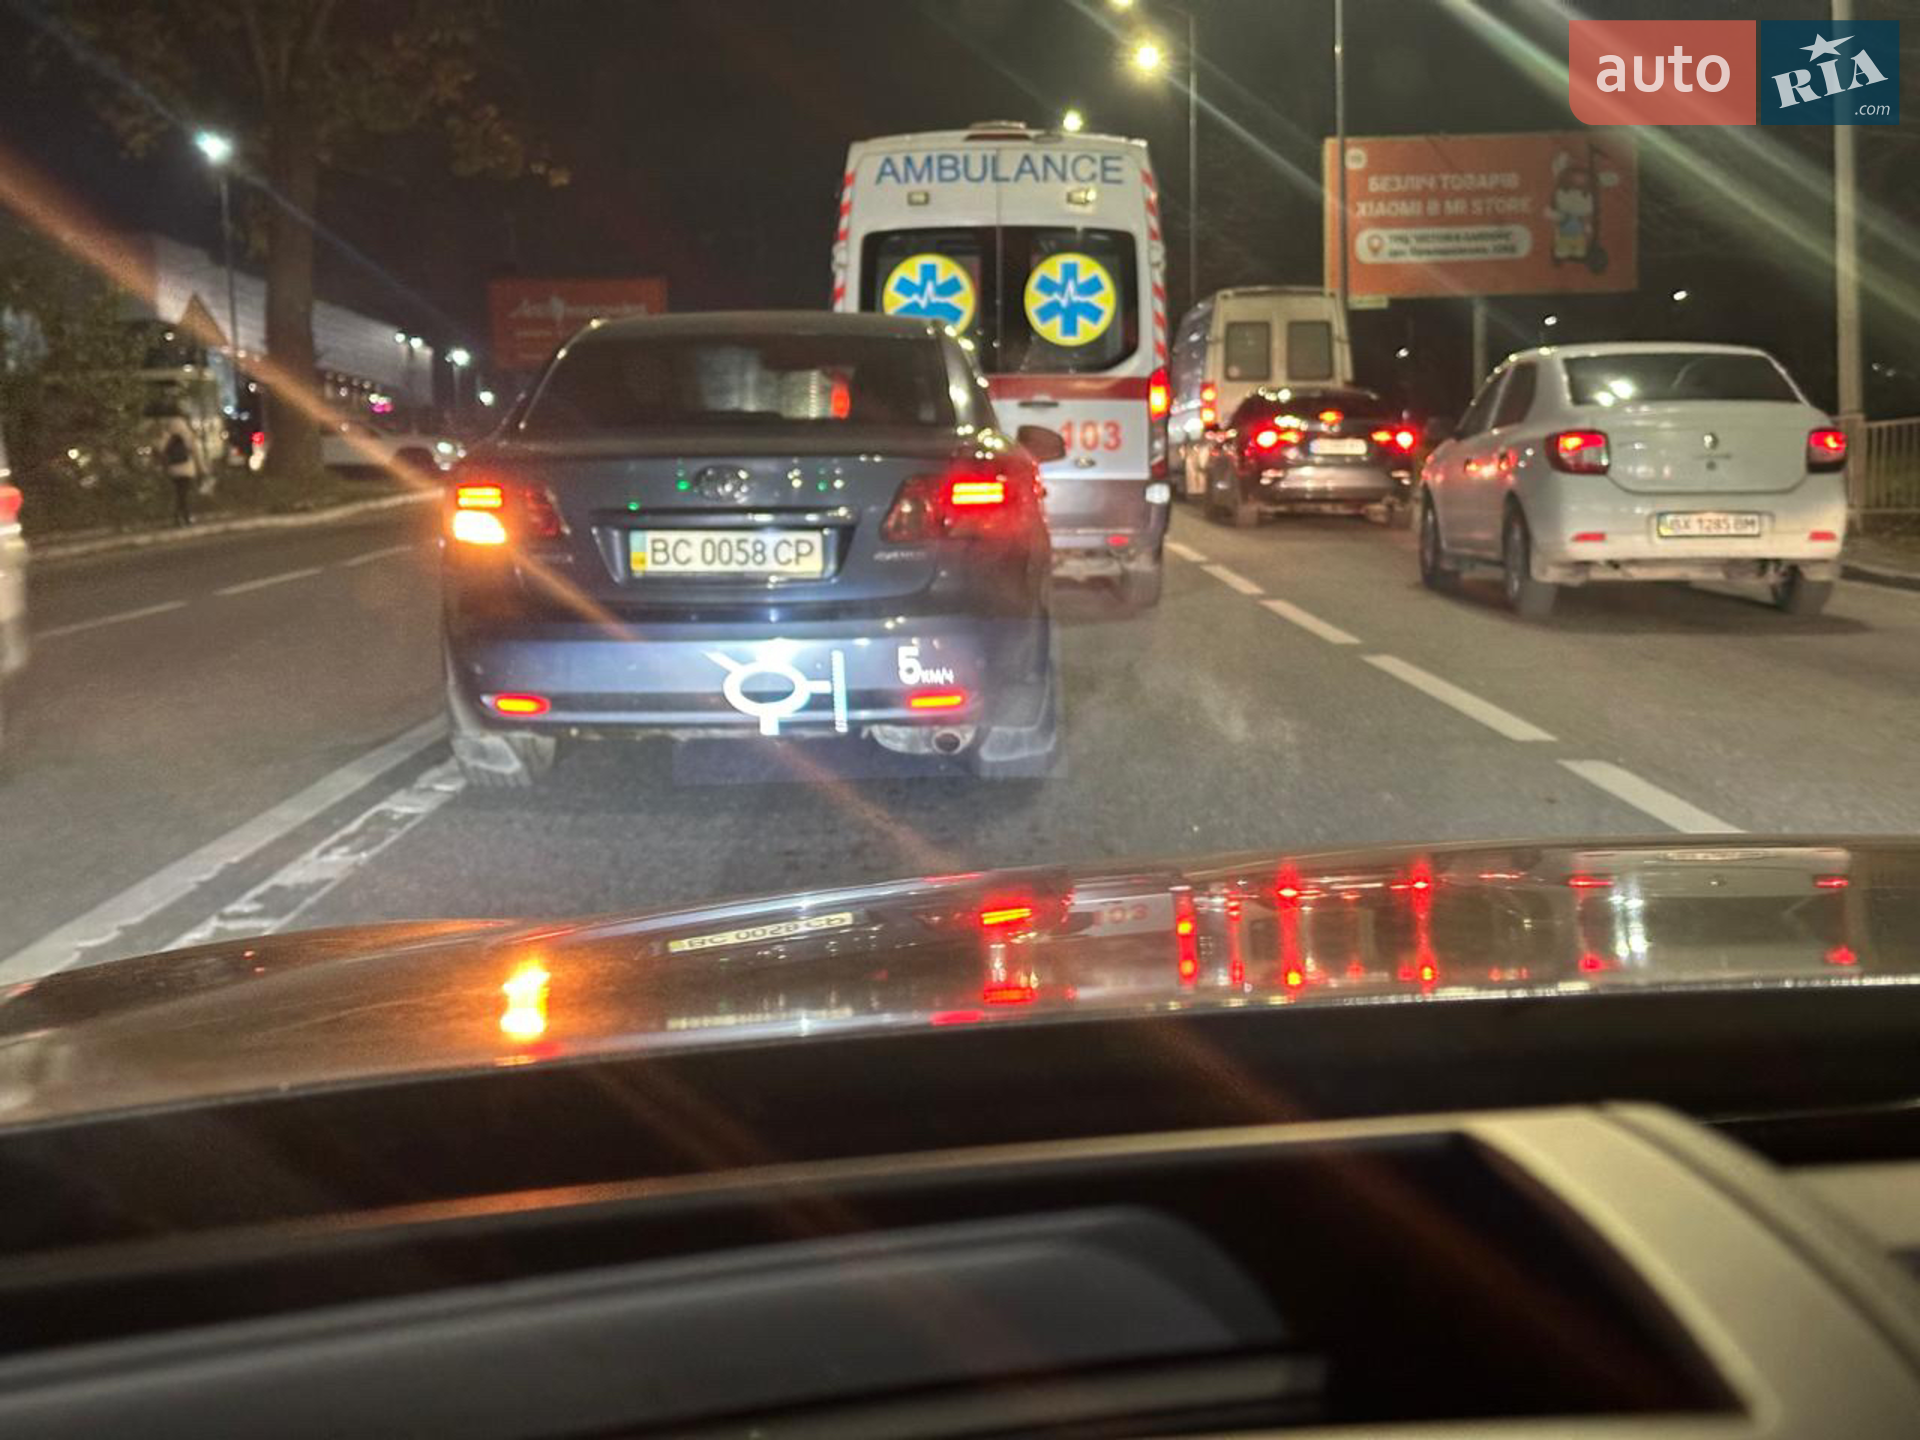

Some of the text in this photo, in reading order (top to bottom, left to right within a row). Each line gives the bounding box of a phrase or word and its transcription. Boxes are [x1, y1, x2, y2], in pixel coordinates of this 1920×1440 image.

[875, 154, 1124, 185] AMBULANCE
[1060, 420, 1122, 451] 103
[651, 539, 814, 566] BC 0058 CP
[898, 646, 921, 685] 5
